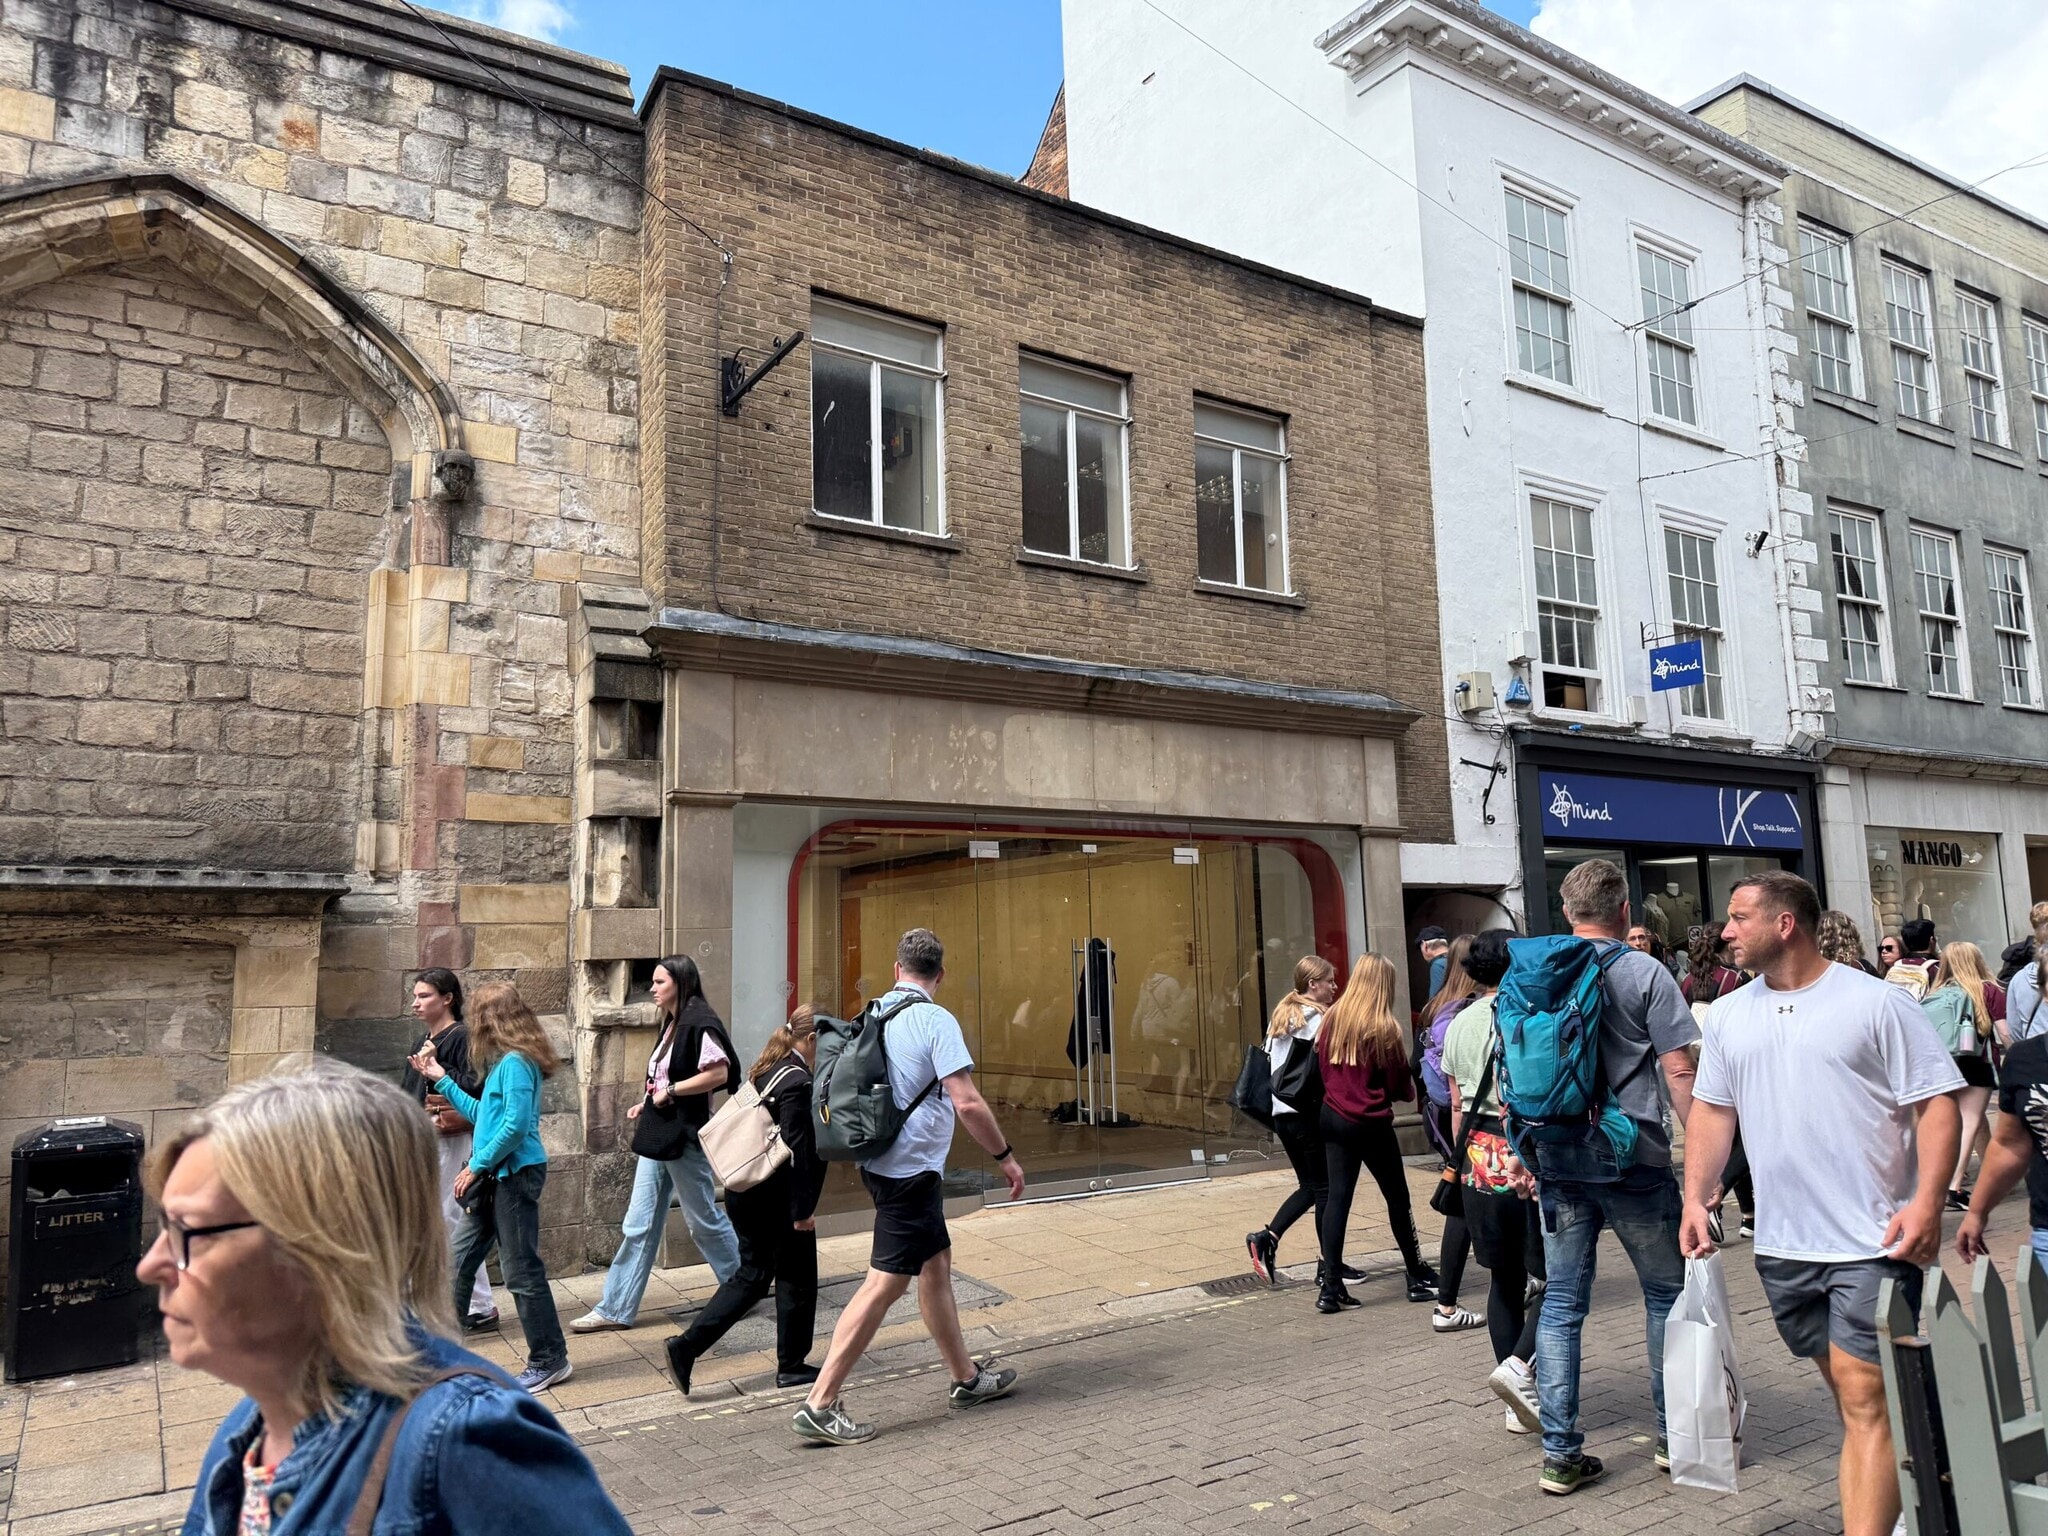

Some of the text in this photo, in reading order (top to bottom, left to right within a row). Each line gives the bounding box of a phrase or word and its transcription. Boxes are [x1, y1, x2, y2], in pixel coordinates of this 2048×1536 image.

[1669, 658, 1701, 674] mind
[1572, 802, 1613, 821] mind
[1901, 840, 1963, 867] MANGO
[48, 1211, 104, 1227] LITTER
